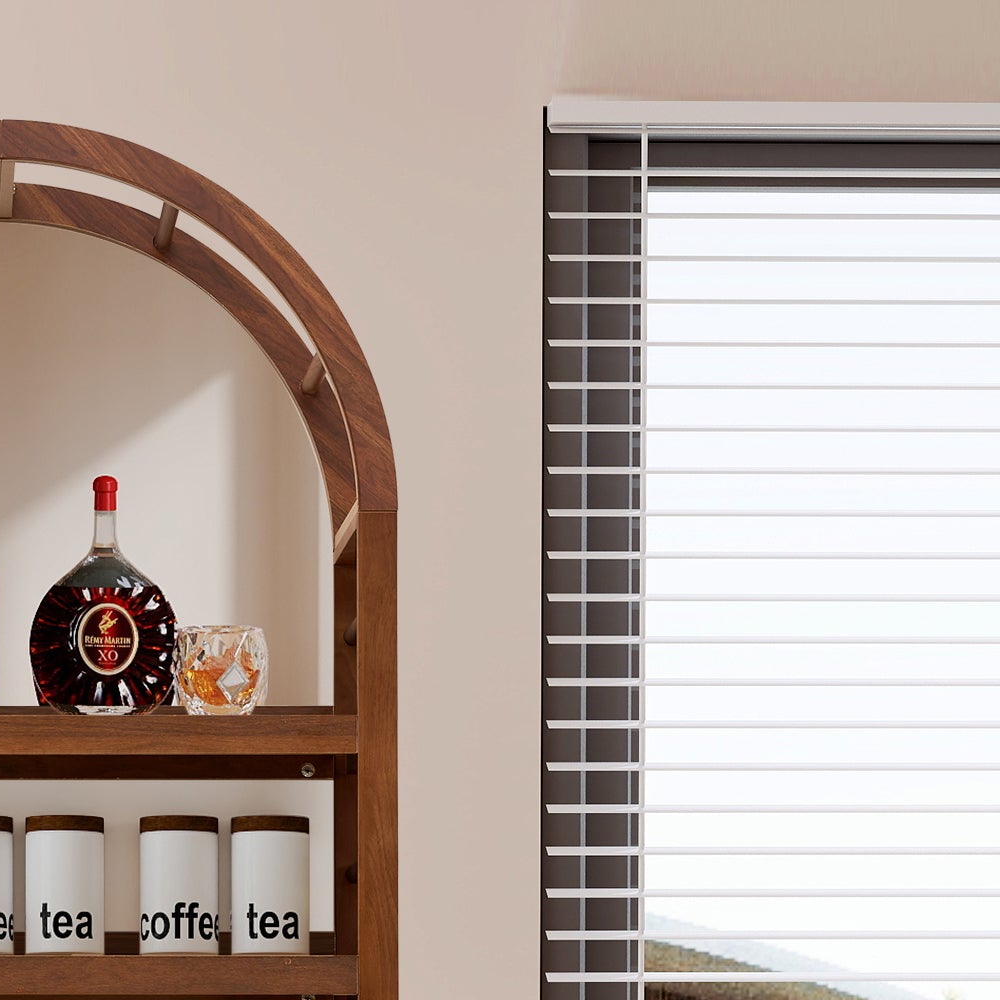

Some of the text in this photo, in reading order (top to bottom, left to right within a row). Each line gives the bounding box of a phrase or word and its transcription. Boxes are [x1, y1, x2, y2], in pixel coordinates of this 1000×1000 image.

[84, 635, 131, 645] RÉMY MARTIN
[97, 649, 119, 662] XO
[40, 902, 93, 940] tea
[246, 903, 300, 940] tea
